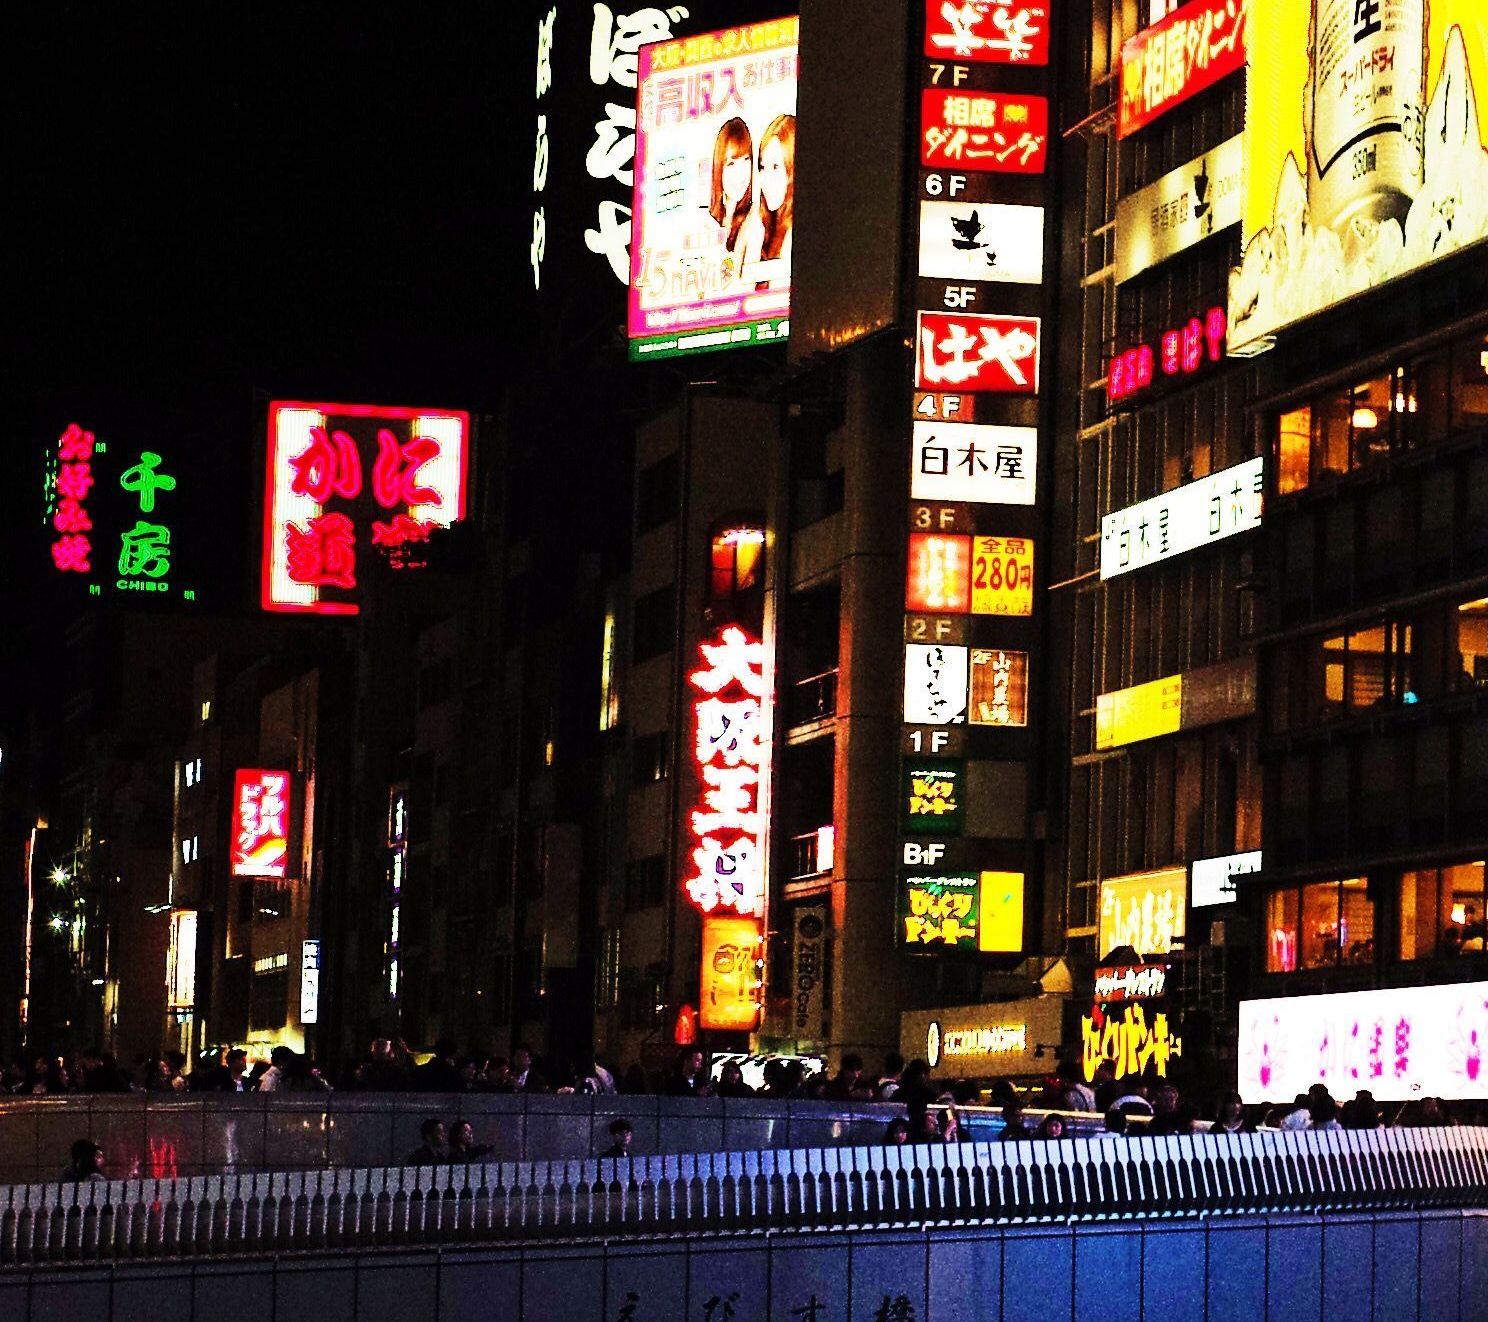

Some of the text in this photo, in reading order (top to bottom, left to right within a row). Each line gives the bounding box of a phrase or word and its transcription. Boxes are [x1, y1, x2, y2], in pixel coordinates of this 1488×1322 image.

[929, 64, 969, 87] 7F
[656, 67, 745, 127] 高収入
[944, 95, 996, 128] 相席
[925, 126, 1045, 165] ダイニング
[925, 174, 966, 197] 6F
[943, 285, 976, 308] 5F
[922, 322, 1037, 386] はや
[917, 395, 961, 419] 4F
[288, 428, 444, 508] かに
[921, 435, 1025, 480] 白木屋
[118, 452, 176, 578] 千房
[915, 506, 956, 529] 3F
[980, 539, 1026, 555] 全品
[974, 556, 1032, 591] 280円
[116, 579, 169, 592] CHIBO
[912, 619, 952, 640] 2F
[910, 730, 949, 753] 1F
[903, 842, 945, 865] B1F
